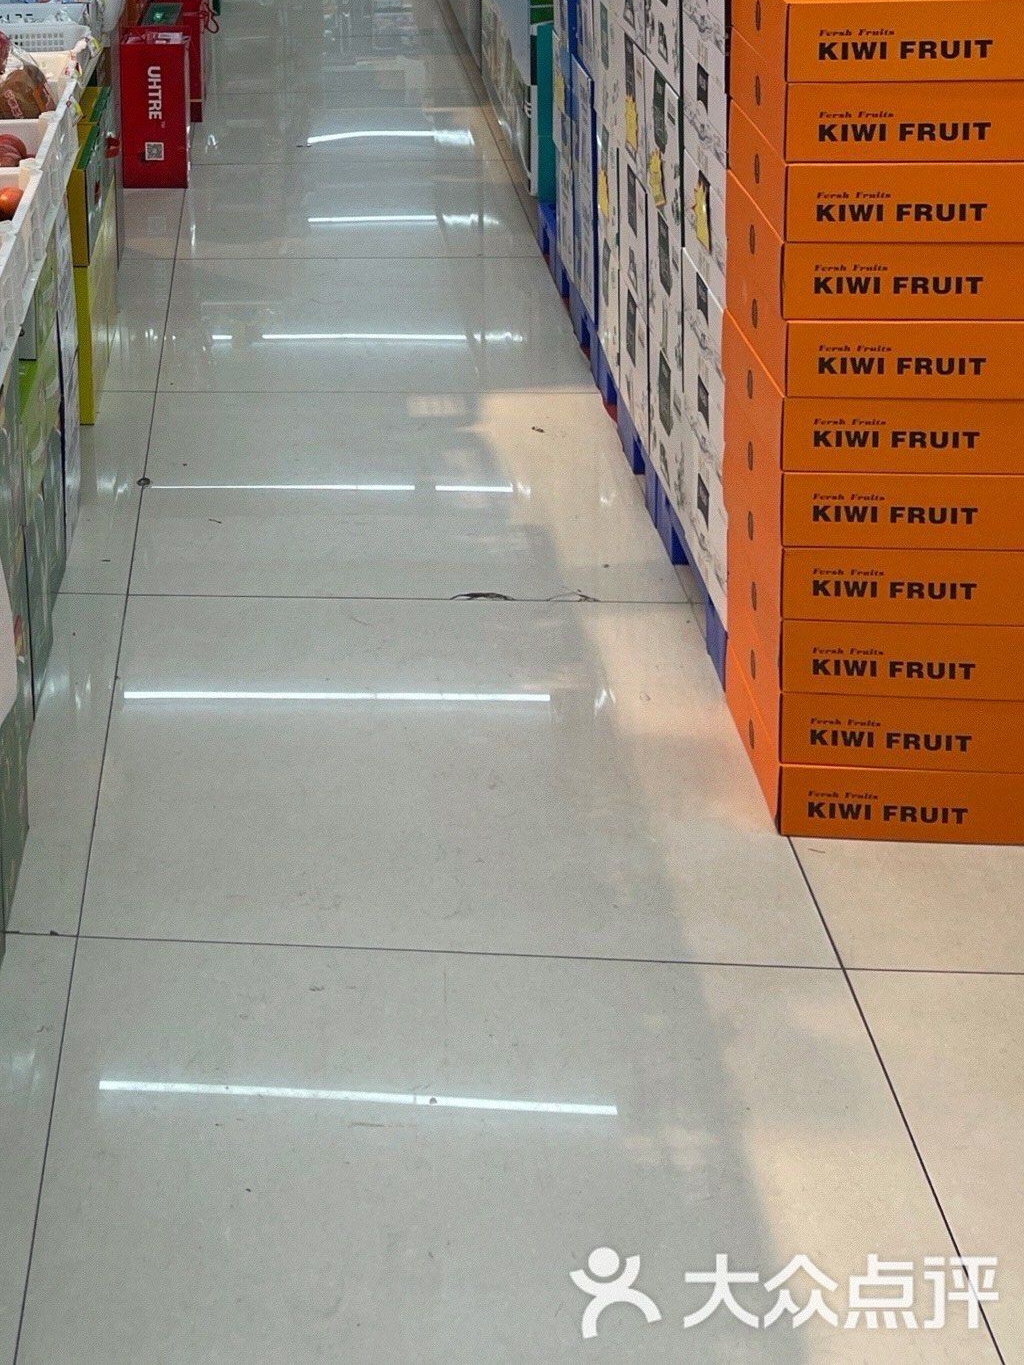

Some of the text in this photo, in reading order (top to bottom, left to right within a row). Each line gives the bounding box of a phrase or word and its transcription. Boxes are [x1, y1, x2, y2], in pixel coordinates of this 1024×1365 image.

[818, 40, 994, 60] KIWI FRUIT
[147, 64, 163, 121] UHTRE
[818, 123, 992, 142] KIWI FRUIT
[816, 204, 988, 222] KIWI FRUIT
[813, 277, 984, 294] KIWI FRUIT
[817, 357, 987, 375] KIWI FRUIT
[813, 431, 981, 448] KIWI FRUIT
[812, 506, 979, 524] KIWI FRUIT
[812, 580, 978, 600] KIWI FRUIT
[811, 659, 976, 680] KIWI FRUIT
[809, 729, 973, 752] KIWI FRUIT
[807, 802, 969, 824] KIWI FRUIT
